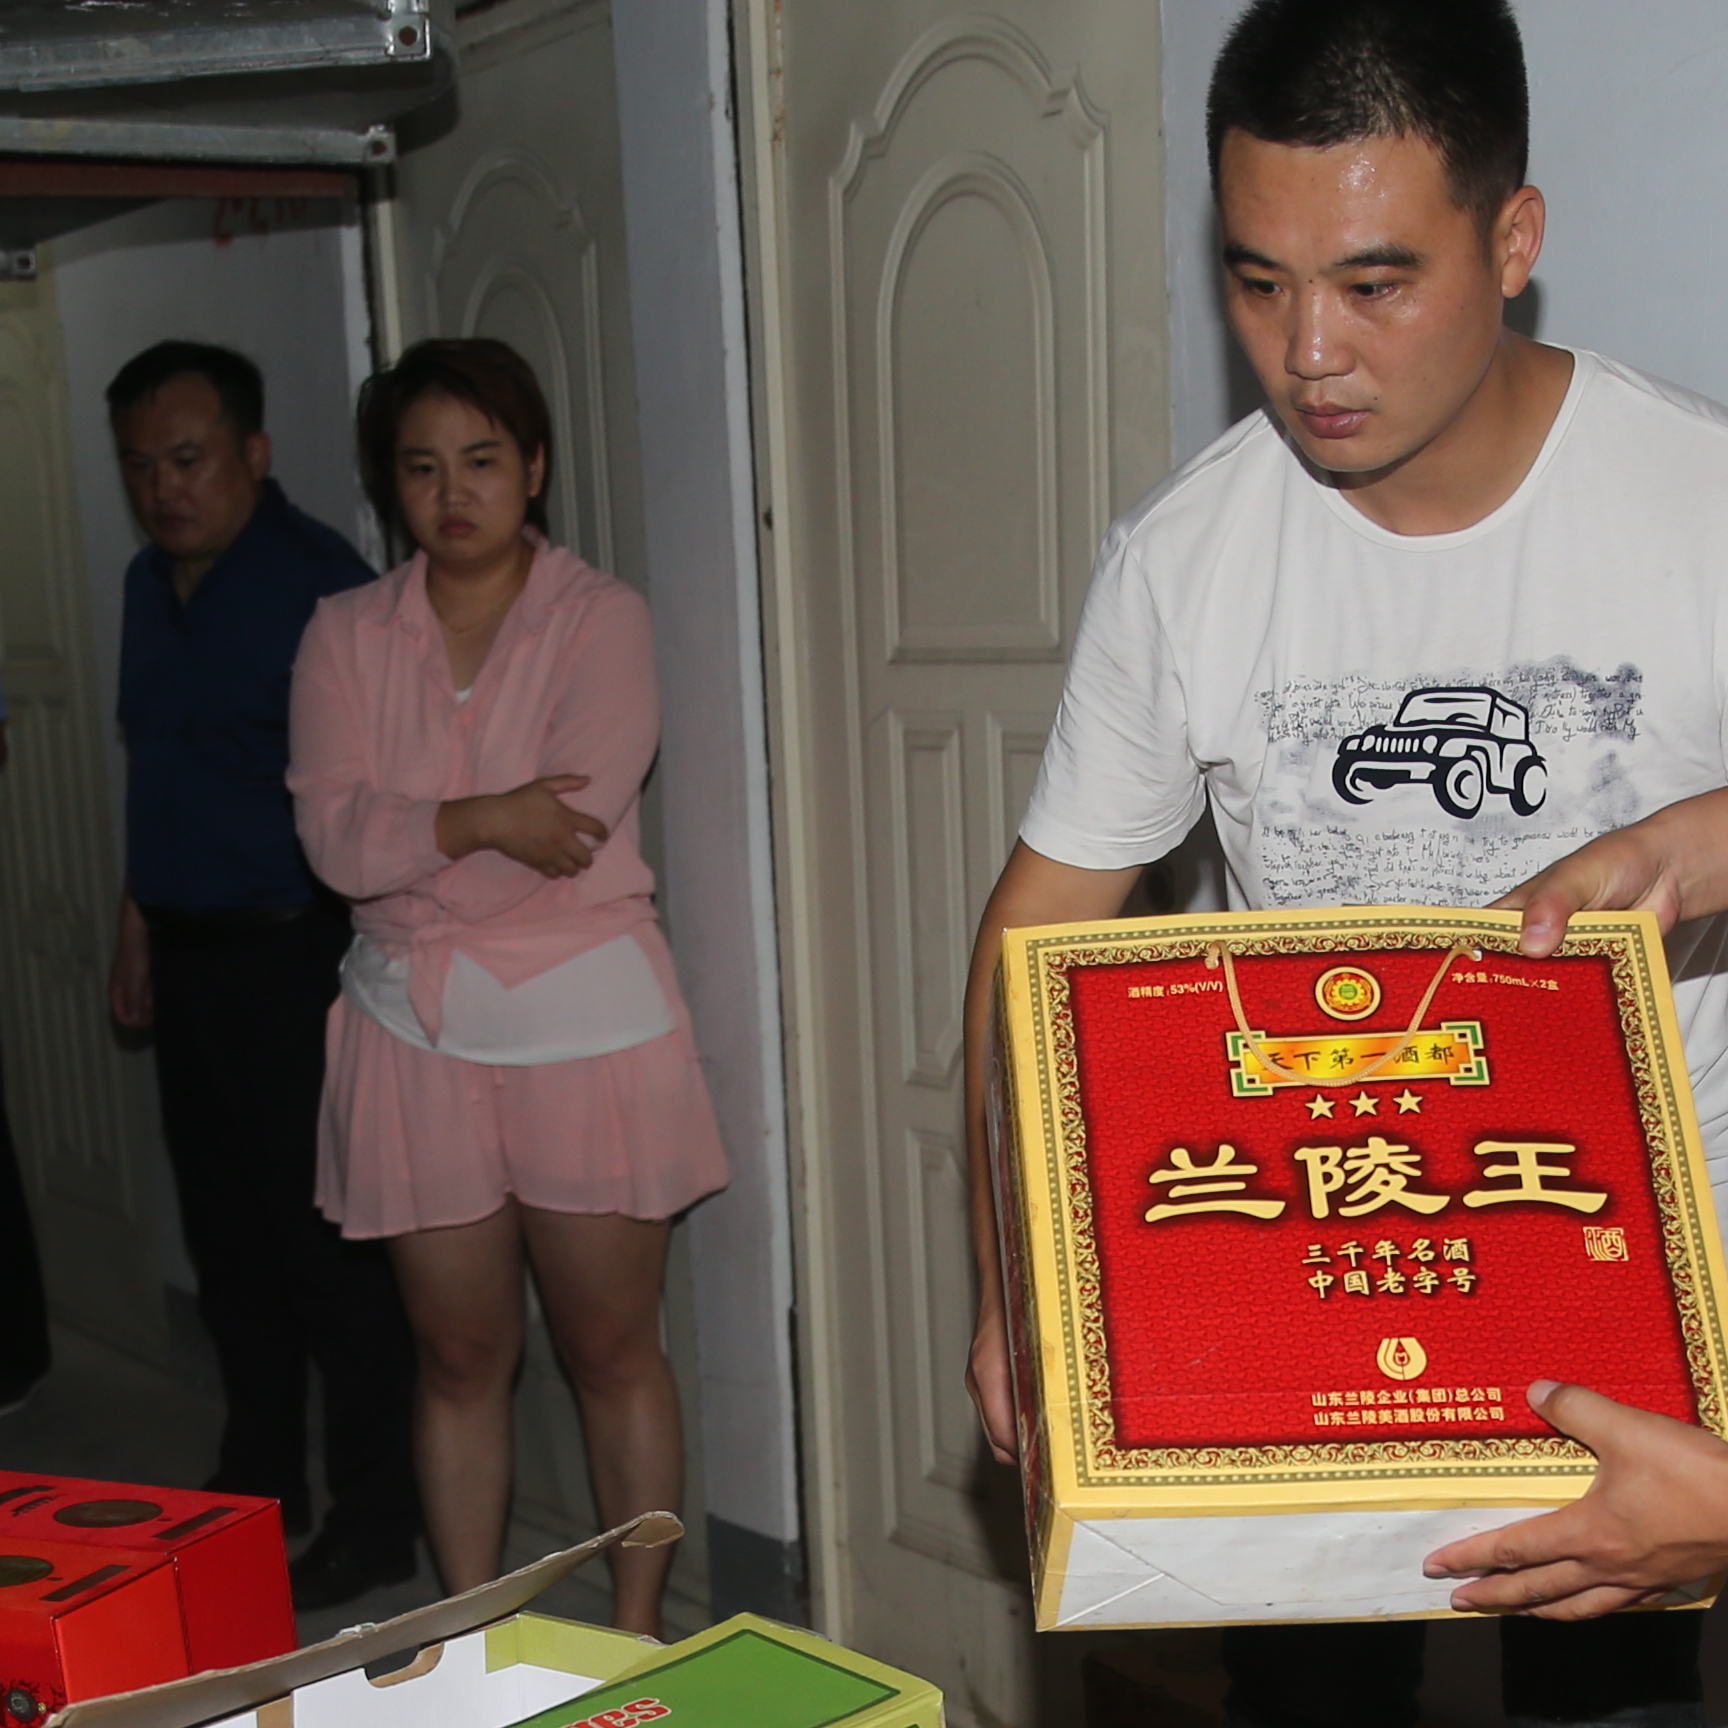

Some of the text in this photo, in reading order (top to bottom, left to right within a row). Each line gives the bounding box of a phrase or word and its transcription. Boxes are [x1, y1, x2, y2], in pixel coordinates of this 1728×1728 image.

[1262, 1044, 1455, 1072] 天下第一酒都
[1144, 1136, 1608, 1223] 兰陵王
[1301, 1237, 1471, 1266] 三千年名酒
[1307, 1267, 1477, 1298] 中国老字号
[1311, 1386, 1503, 1406] 山东兰陵企业(集团)总公司
[1313, 1406, 1505, 1427] 山东兰陵美酒股份有限公司
